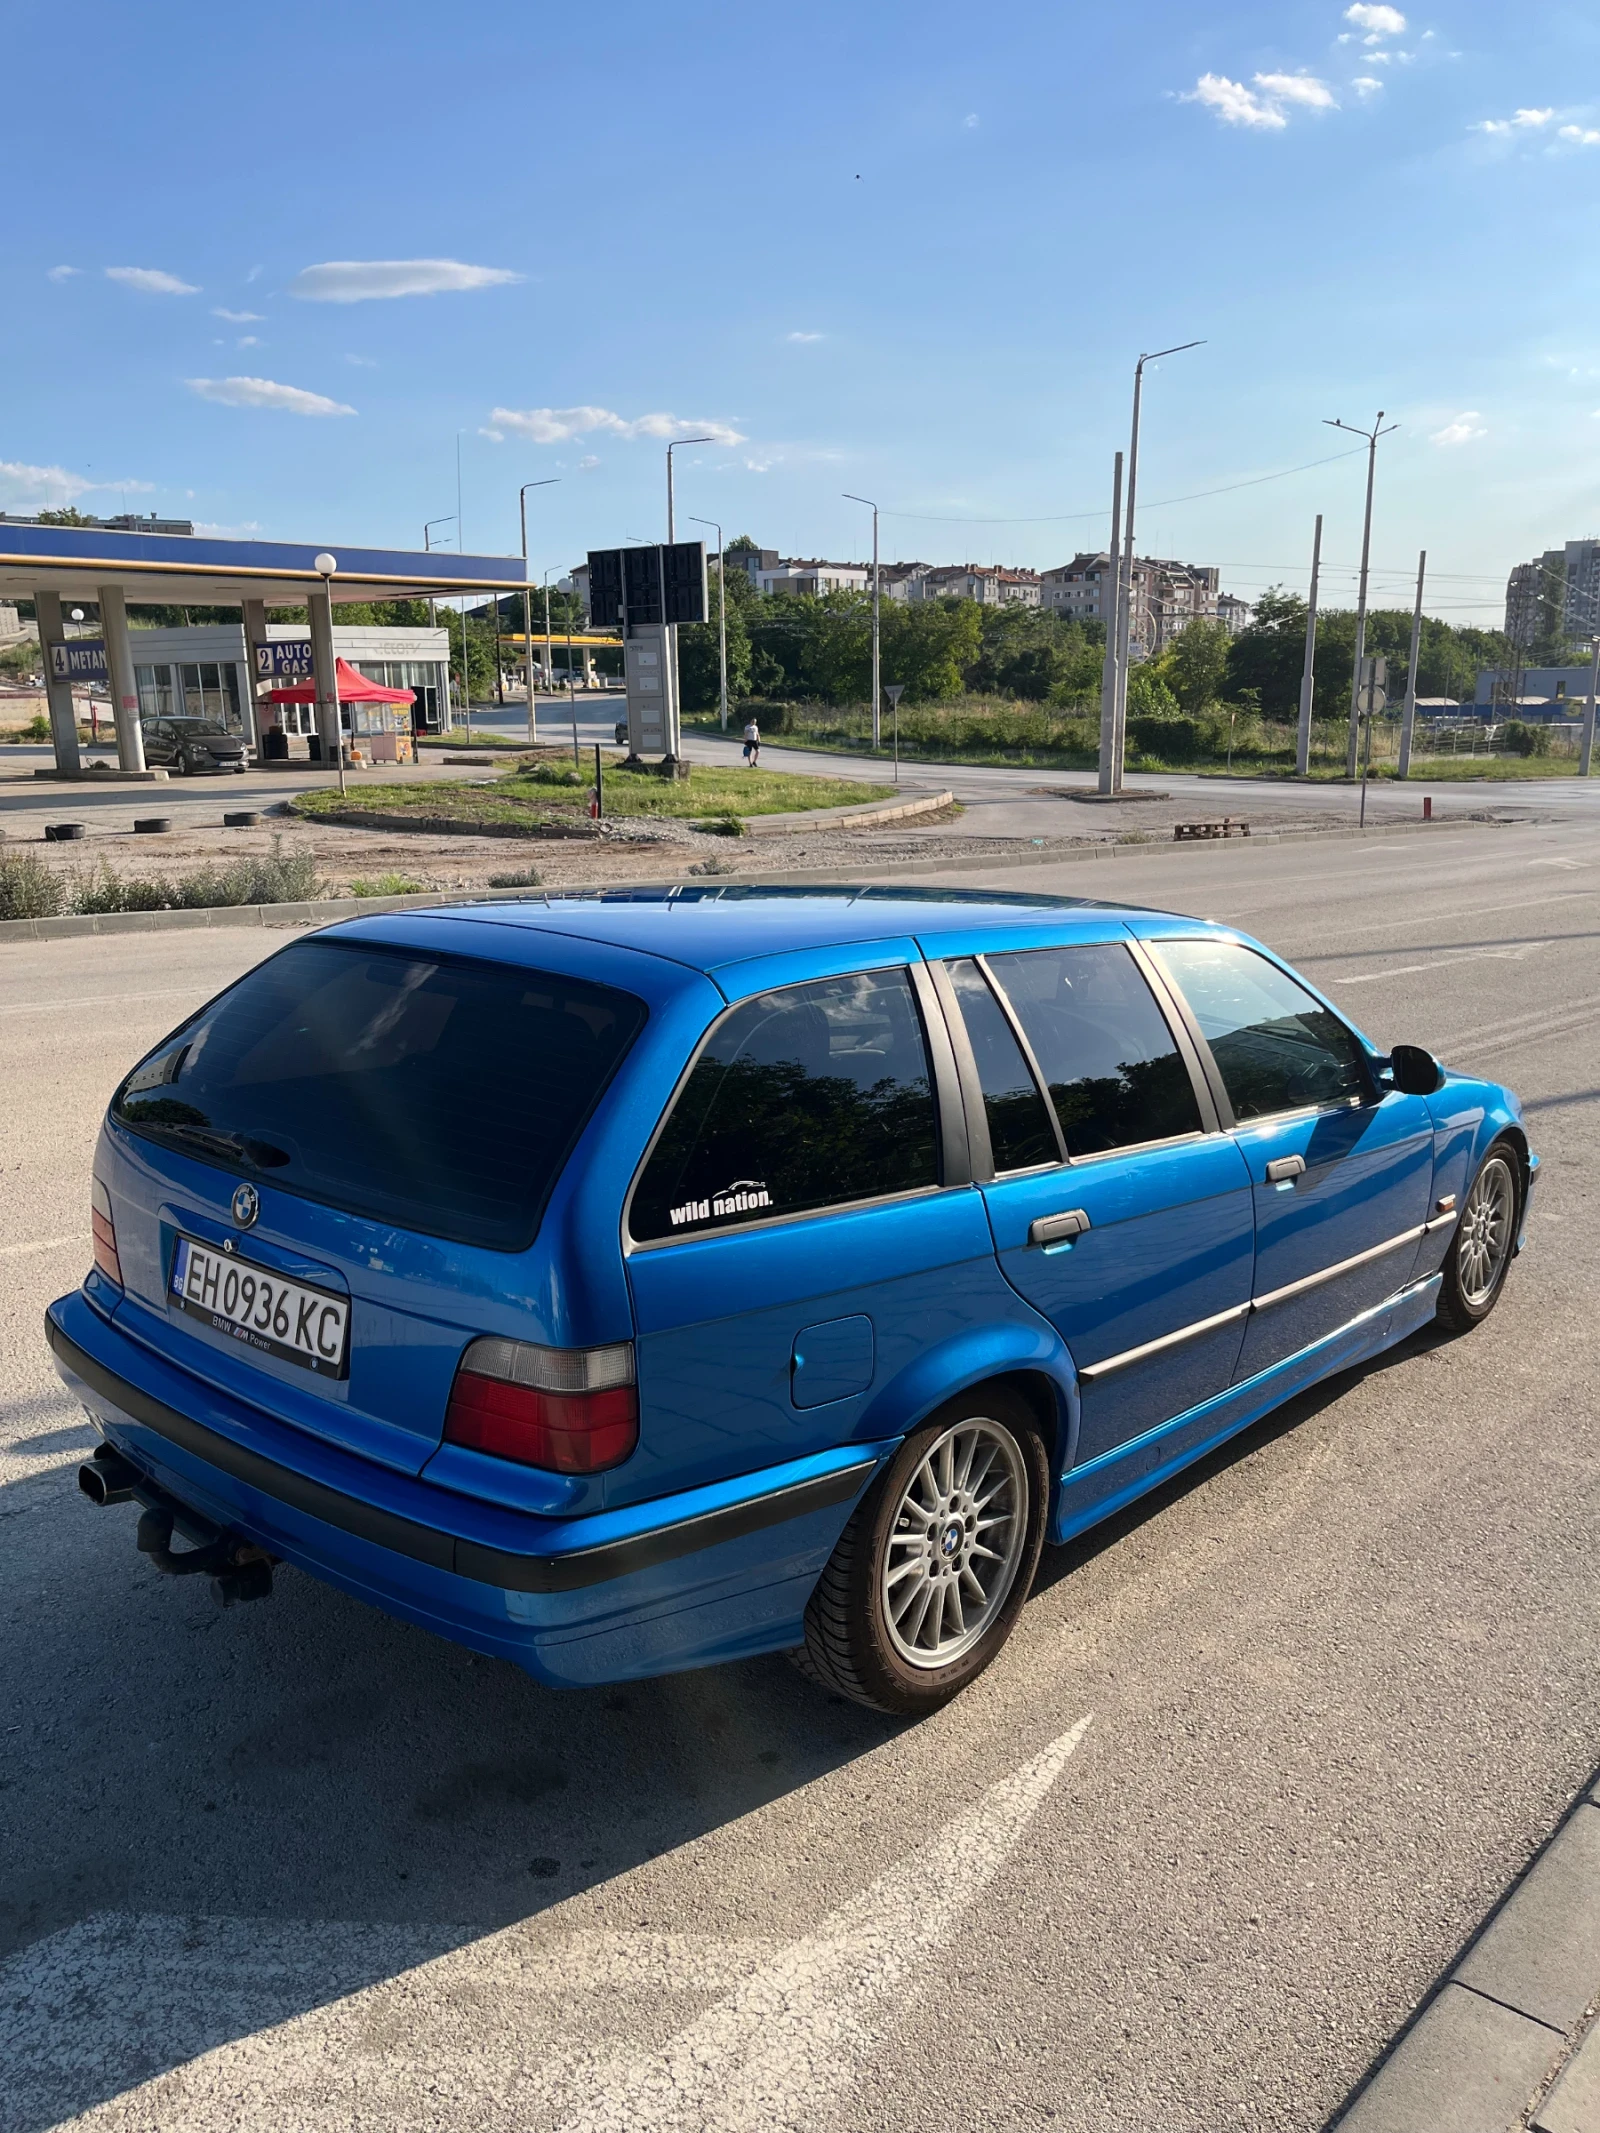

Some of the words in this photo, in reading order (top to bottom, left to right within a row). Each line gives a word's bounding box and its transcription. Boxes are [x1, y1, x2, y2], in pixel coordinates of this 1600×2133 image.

[55, 648, 65, 671] 4
[69, 649, 107, 670] METAN
[260, 649, 270, 670] 2
[276, 643, 312, 659] AUTO
[281, 659, 309, 674] GAS
[670, 1199, 710, 1225] wild
[713, 1190, 774, 1216] nation.
[173, 1274, 184, 1290] BG
[212, 1315, 231, 1332] BMW
[250, 1334, 271, 1350] Power
